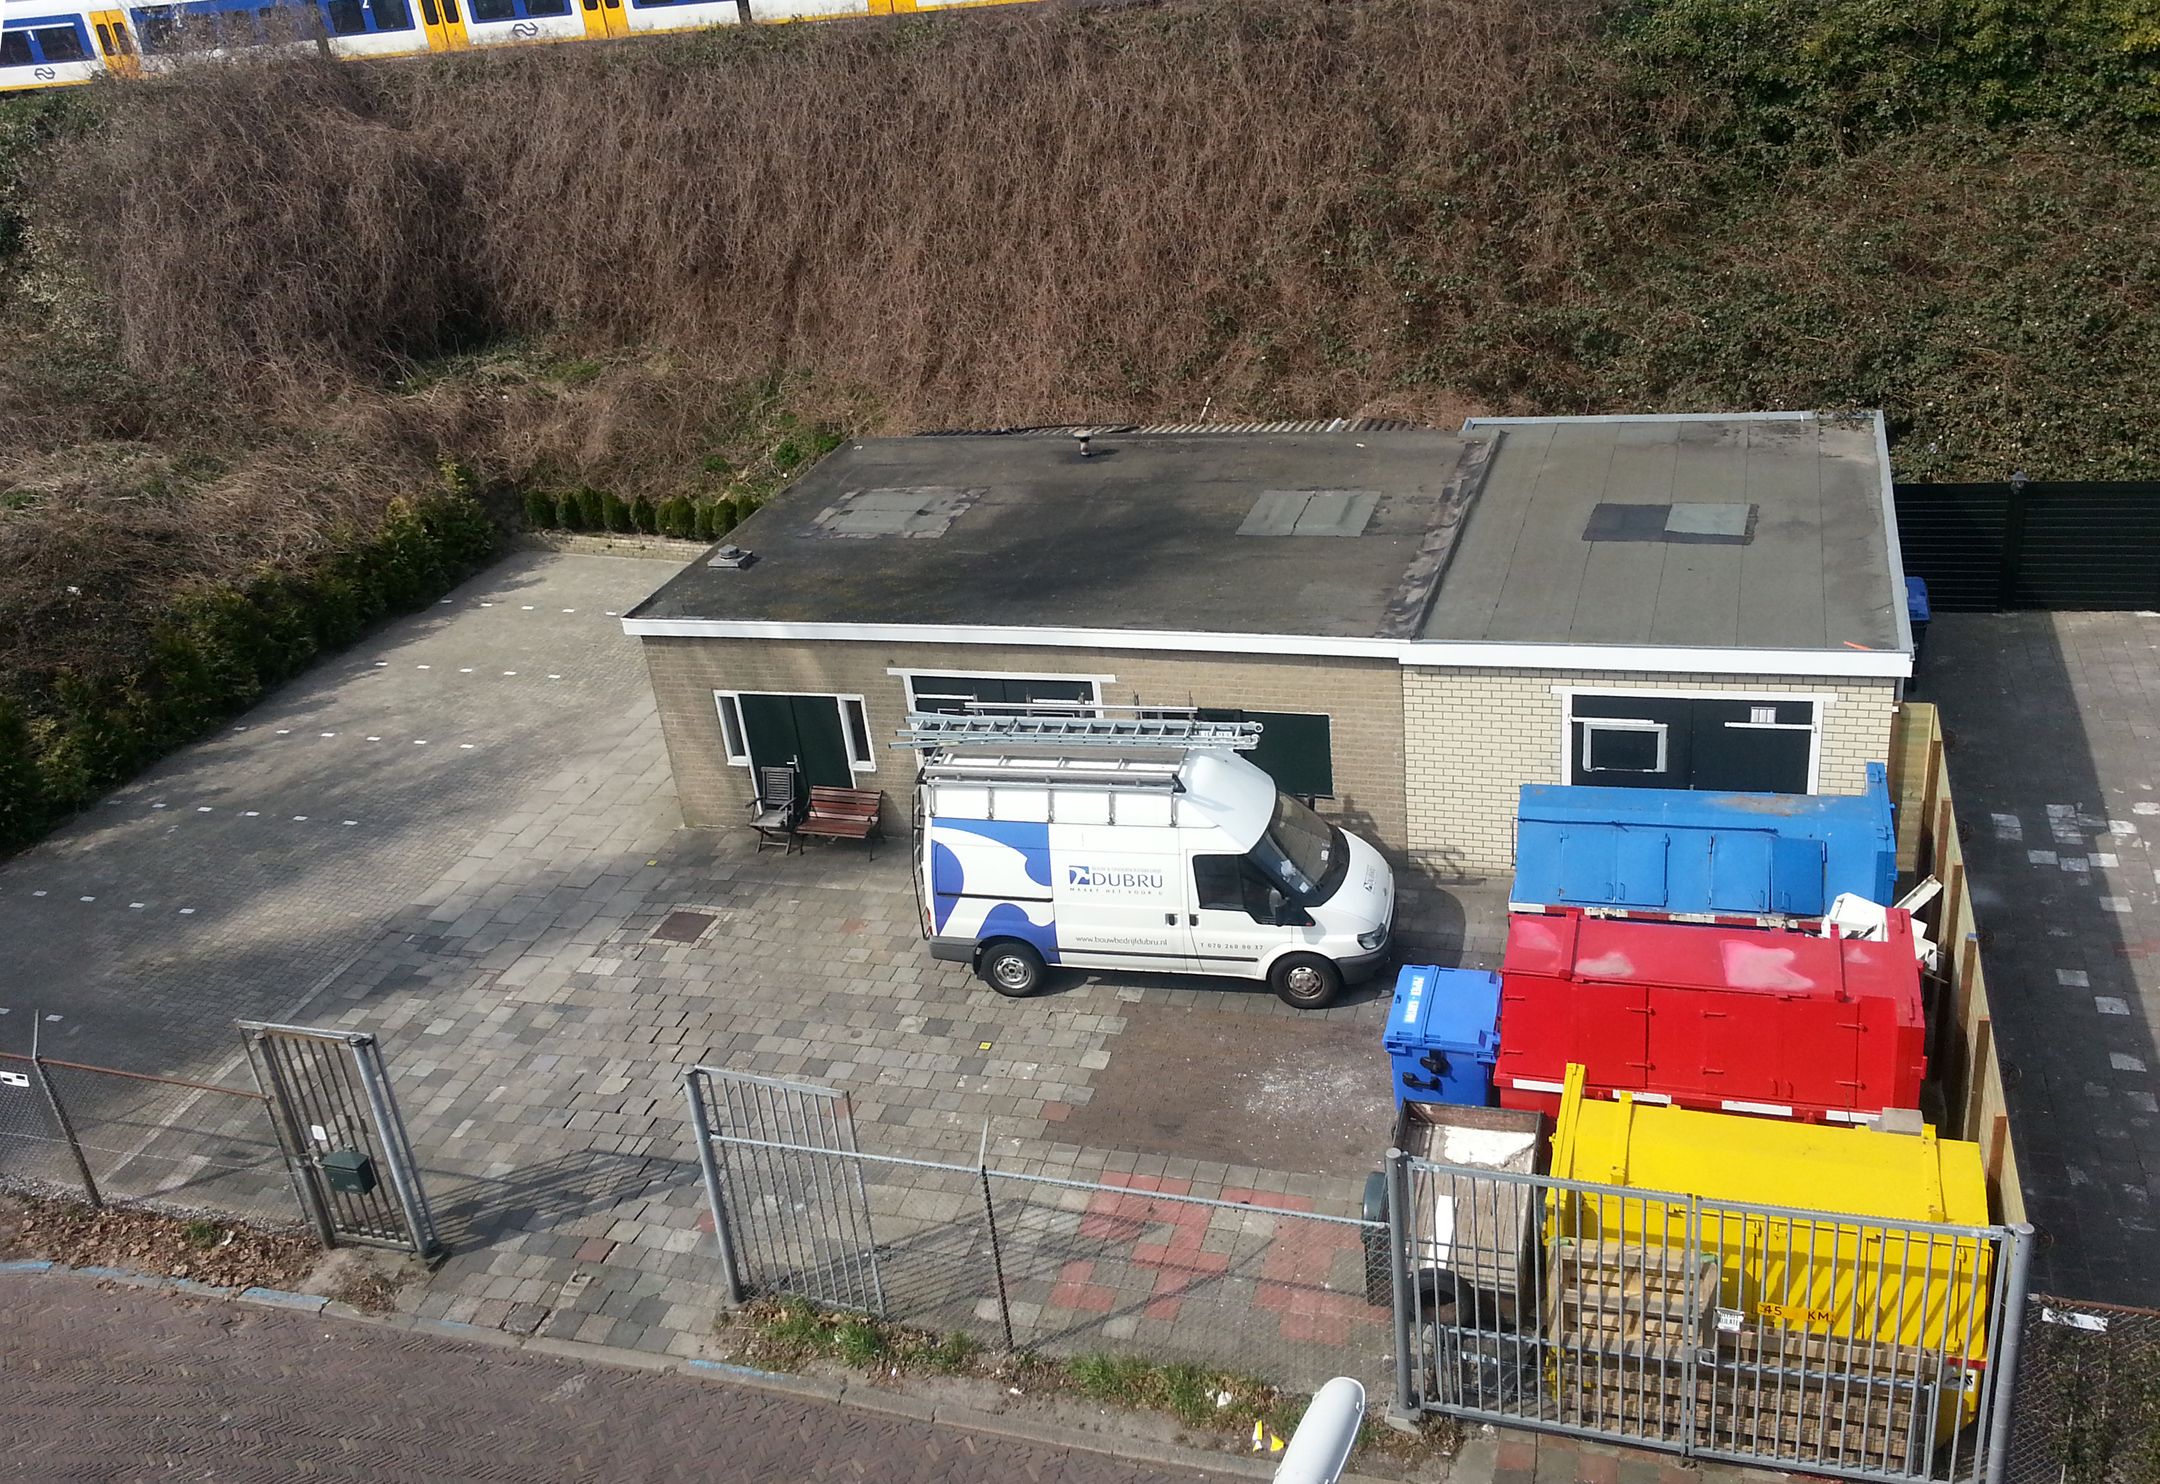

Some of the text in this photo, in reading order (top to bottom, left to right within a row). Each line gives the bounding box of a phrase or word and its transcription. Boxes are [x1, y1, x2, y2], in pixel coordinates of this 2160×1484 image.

[27, 30, 35, 41] 1
[1092, 872, 1163, 888] DUBRU
[1075, 936, 1168, 946] www.bouwbedrijfdubru.nl
[1763, 1305, 1830, 1321] 45 KM
